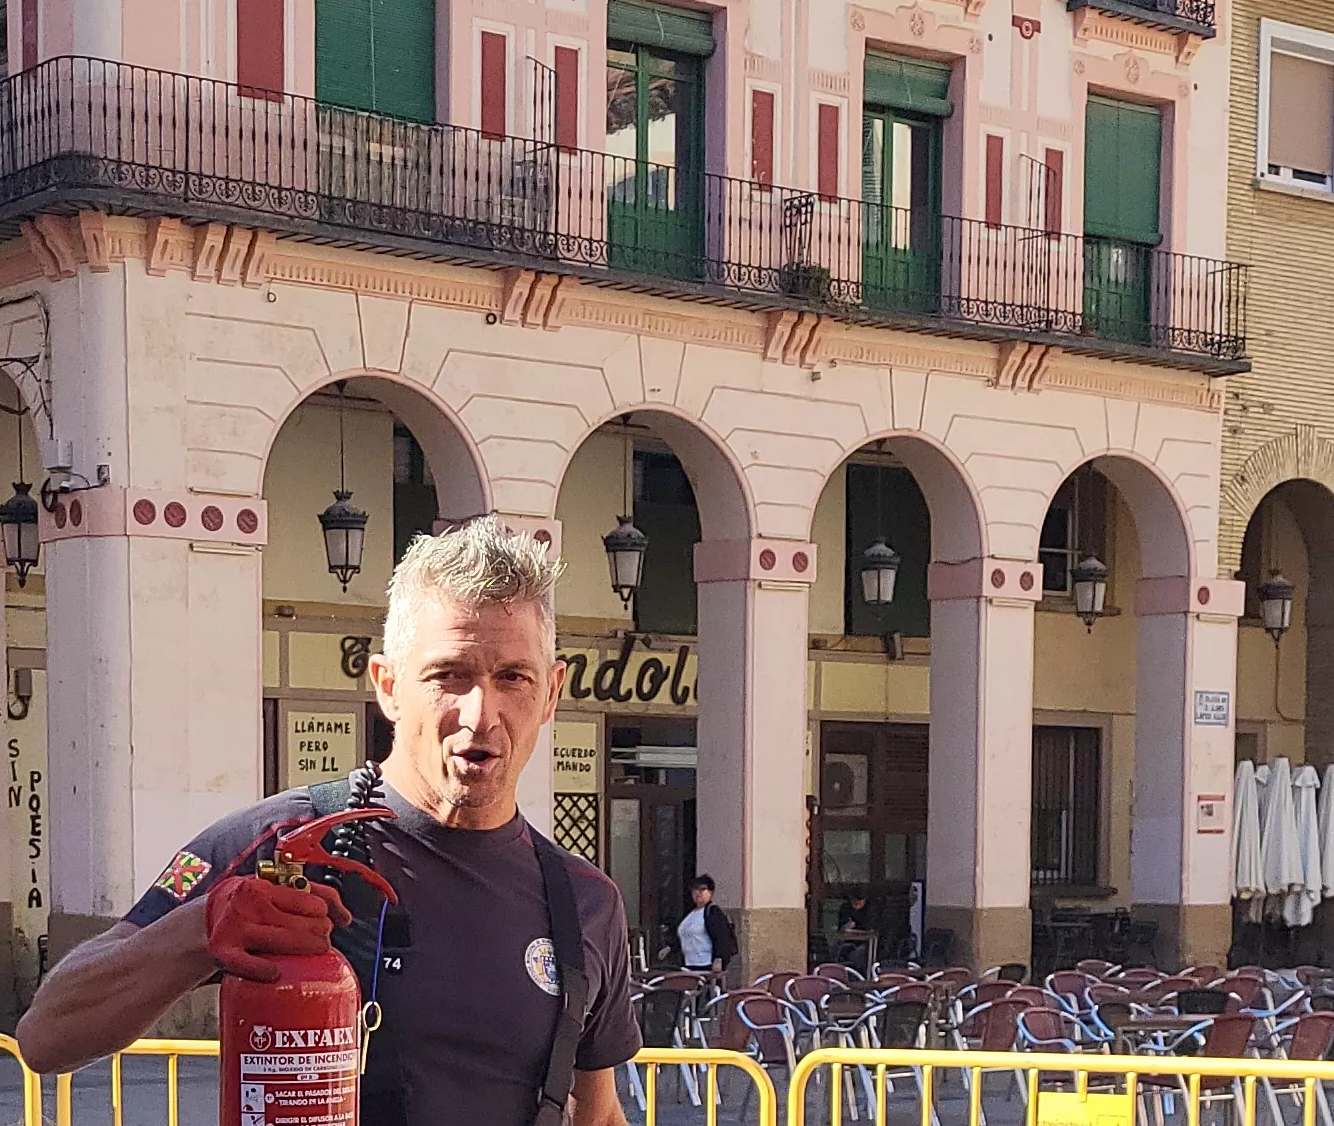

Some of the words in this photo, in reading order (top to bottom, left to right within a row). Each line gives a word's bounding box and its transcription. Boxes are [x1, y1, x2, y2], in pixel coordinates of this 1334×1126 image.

[299, 740, 329, 752] PERO
[553, 747, 597, 758] ECUERDO
[298, 757, 316, 771] SIN
[321, 756, 338, 772] LL
[553, 760, 591, 772] MANDO
[383, 957, 402, 970] 74
[274, 1026, 355, 1048] EXFAEX
[244, 1055, 295, 1065] EXTINTOR
[298, 1056, 311, 1064] DE
